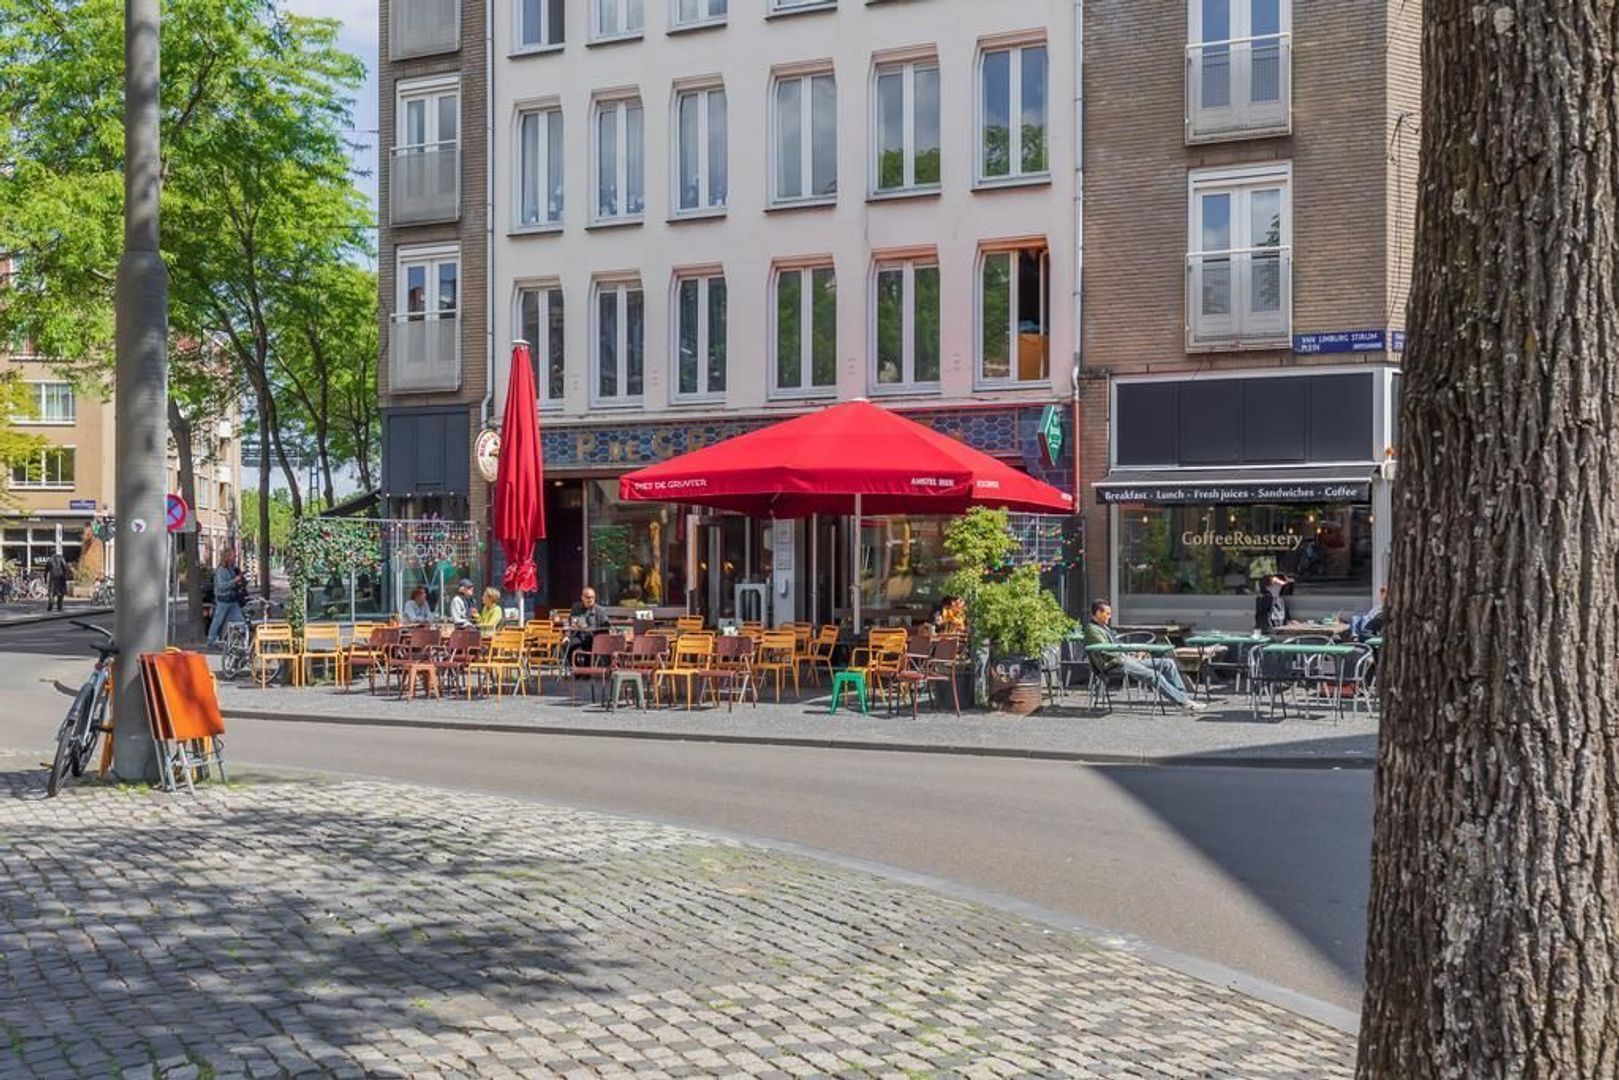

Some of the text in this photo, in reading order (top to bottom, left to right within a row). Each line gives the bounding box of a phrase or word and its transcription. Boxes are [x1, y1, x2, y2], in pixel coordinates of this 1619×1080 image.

[1105, 489, 1147, 500] Breakfast
[1156, 489, 1184, 499] Lunch
[1258, 487, 1315, 498] Sandwiches
[1325, 486, 1358, 497] Coffee
